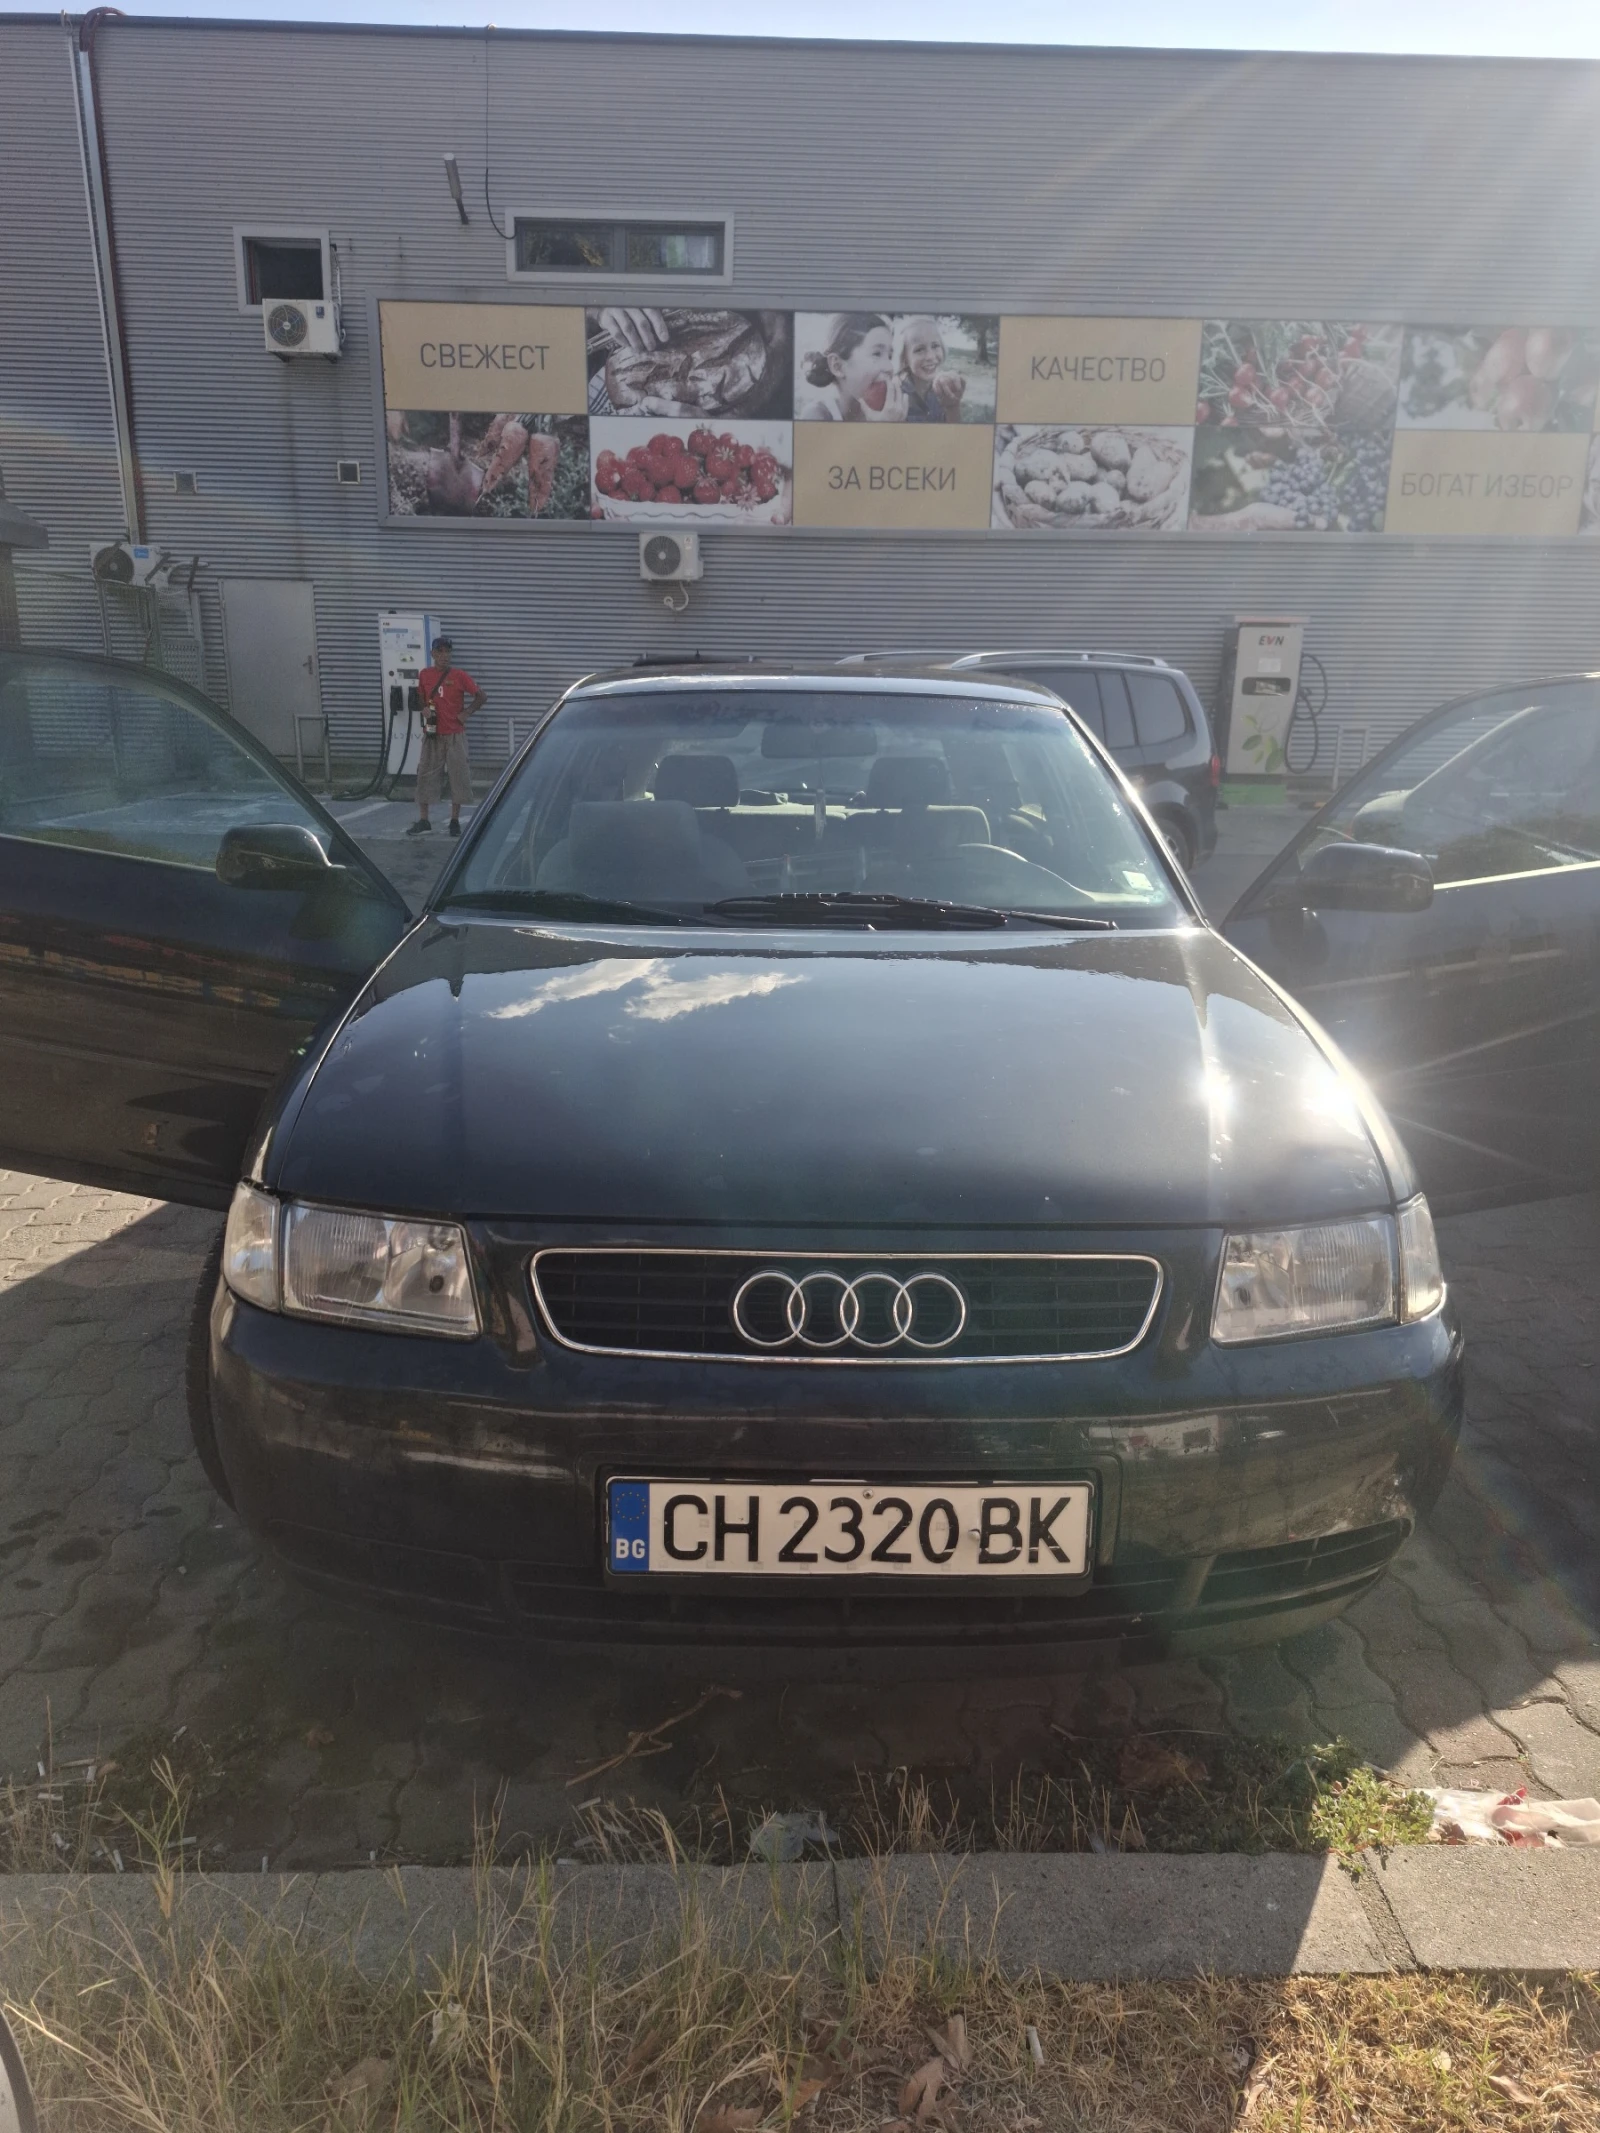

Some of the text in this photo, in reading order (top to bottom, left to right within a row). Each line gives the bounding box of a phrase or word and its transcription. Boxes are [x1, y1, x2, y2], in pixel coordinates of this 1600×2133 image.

[420, 342, 550, 371] СВЕЖЕСТ
[1030, 355, 1167, 383] КАЧЕСТВО
[828, 465, 957, 491] ЗА ВСЕКИ
[1401, 472, 1574, 499] БОГАТ ИЗБОР
[1259, 636, 1285, 646] EVN
[438, 686, 444, 697] 9
[616, 1538, 646, 1558] BG
